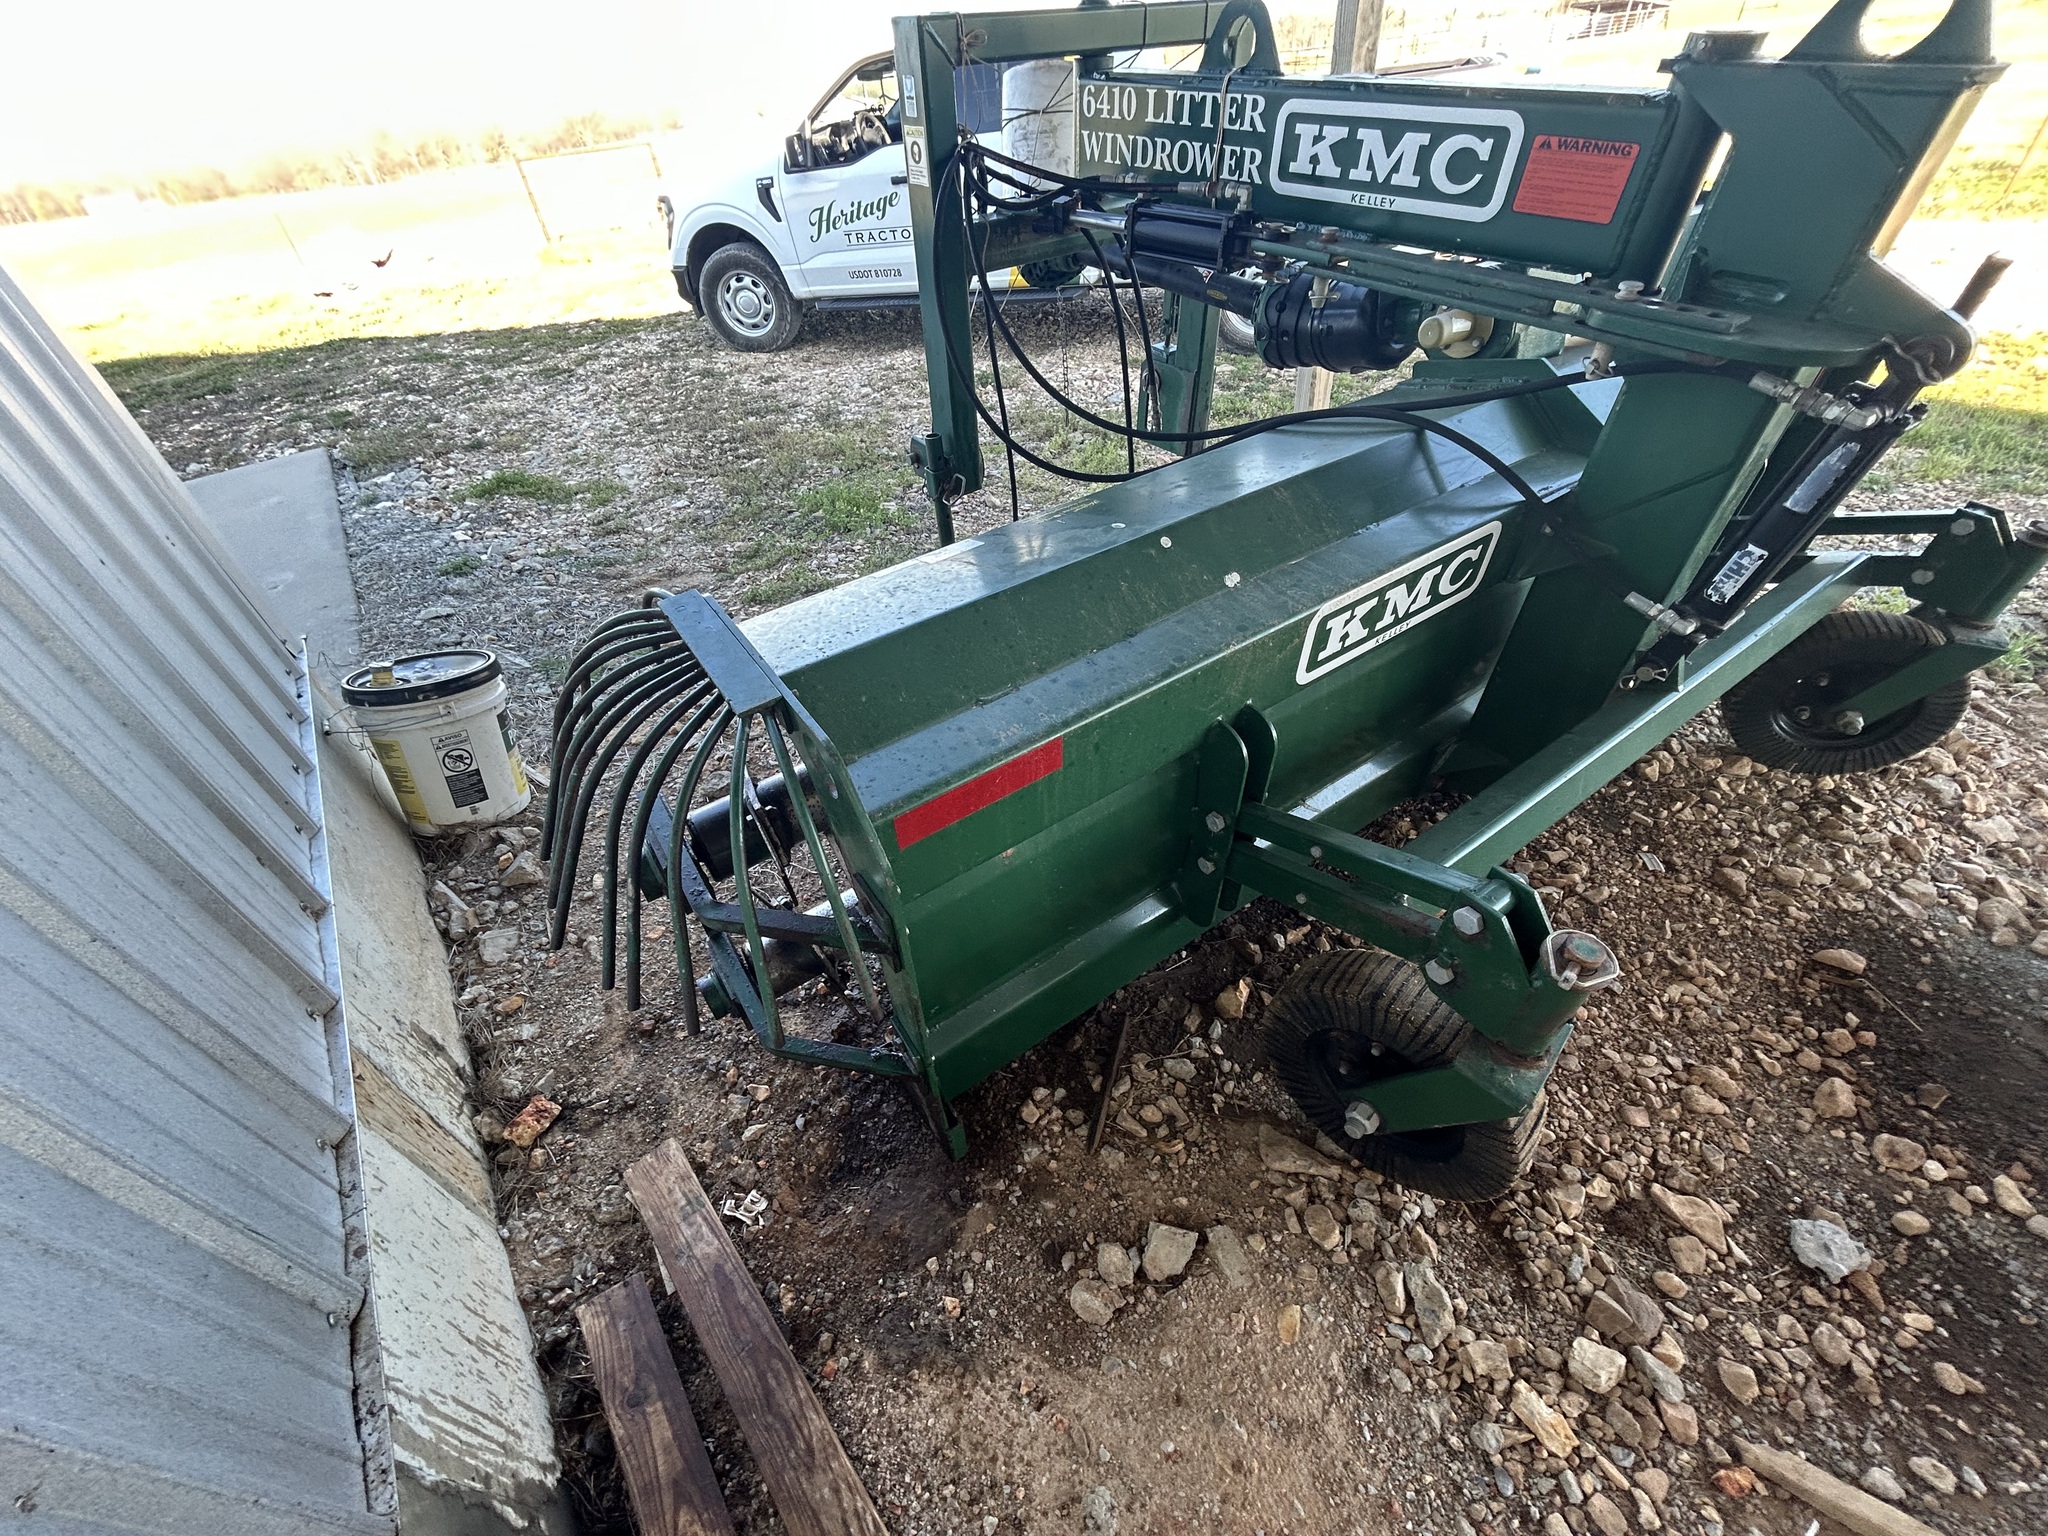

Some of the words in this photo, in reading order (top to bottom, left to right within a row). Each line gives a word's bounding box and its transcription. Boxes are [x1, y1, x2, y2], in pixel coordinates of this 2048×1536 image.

[1082, 85, 1137, 121] 6410
[1144, 88, 1267, 133] LITTER
[1081, 130, 1263, 185] WINDROWER
[1288, 122, 1494, 195] KMC
[1557, 138, 1633, 157] WARNING
[808, 191, 901, 243] Heritage
[1350, 193, 1397, 209] KELLEY
[848, 270, 873, 280] USDOT
[874, 268, 903, 279] 810728
[1317, 544, 1484, 662] KMC
[1374, 620, 1412, 646] KELLEY
